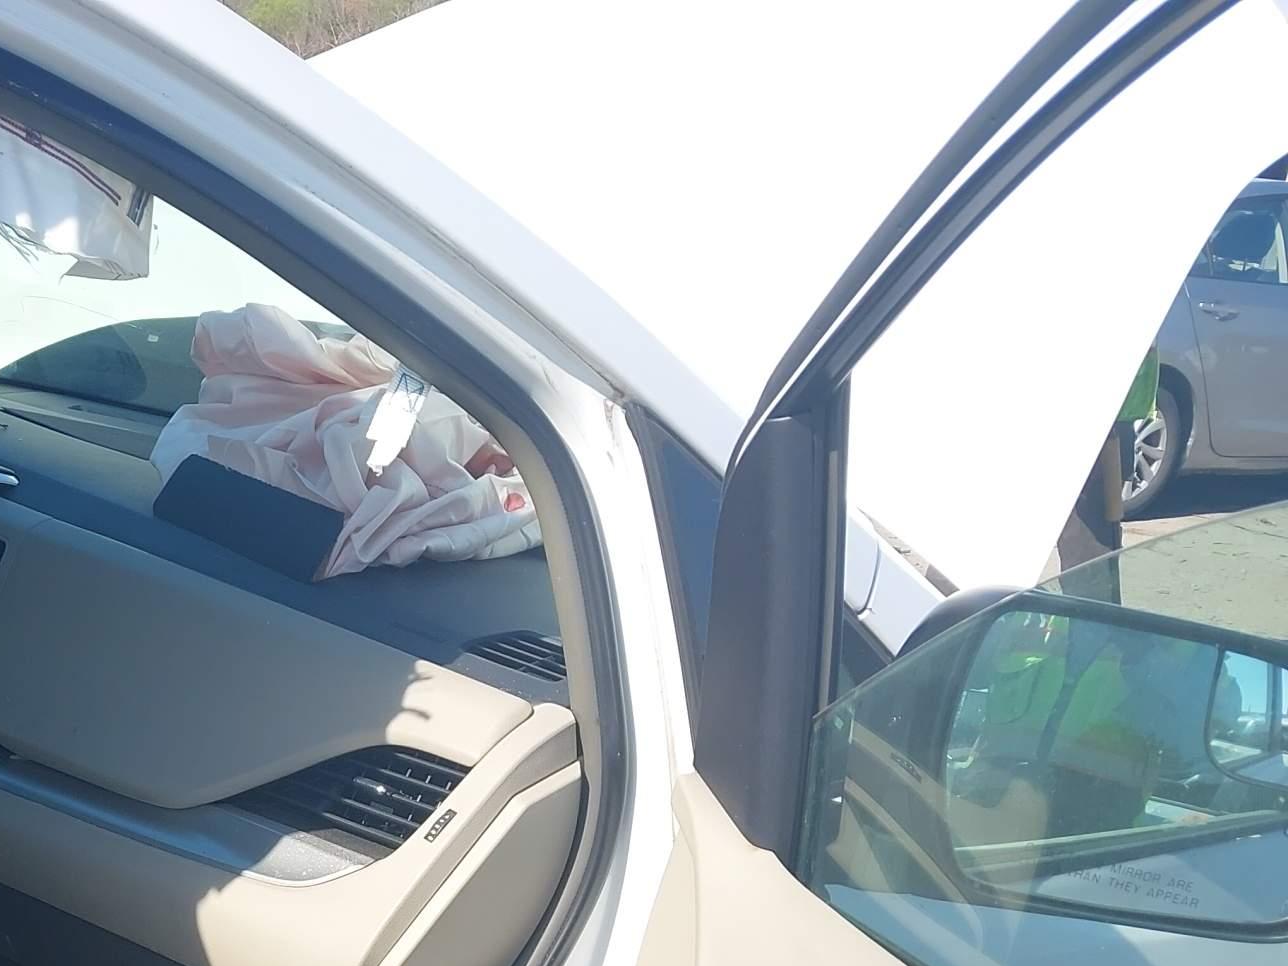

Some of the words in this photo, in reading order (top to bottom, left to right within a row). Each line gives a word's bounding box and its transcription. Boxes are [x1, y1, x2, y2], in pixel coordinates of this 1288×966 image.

[1109, 876, 1141, 894] THEY
[1146, 889, 1200, 909] APPEAR
[1110, 863, 1161, 883] MIRROR
[1167, 877, 1194, 893] ARE
